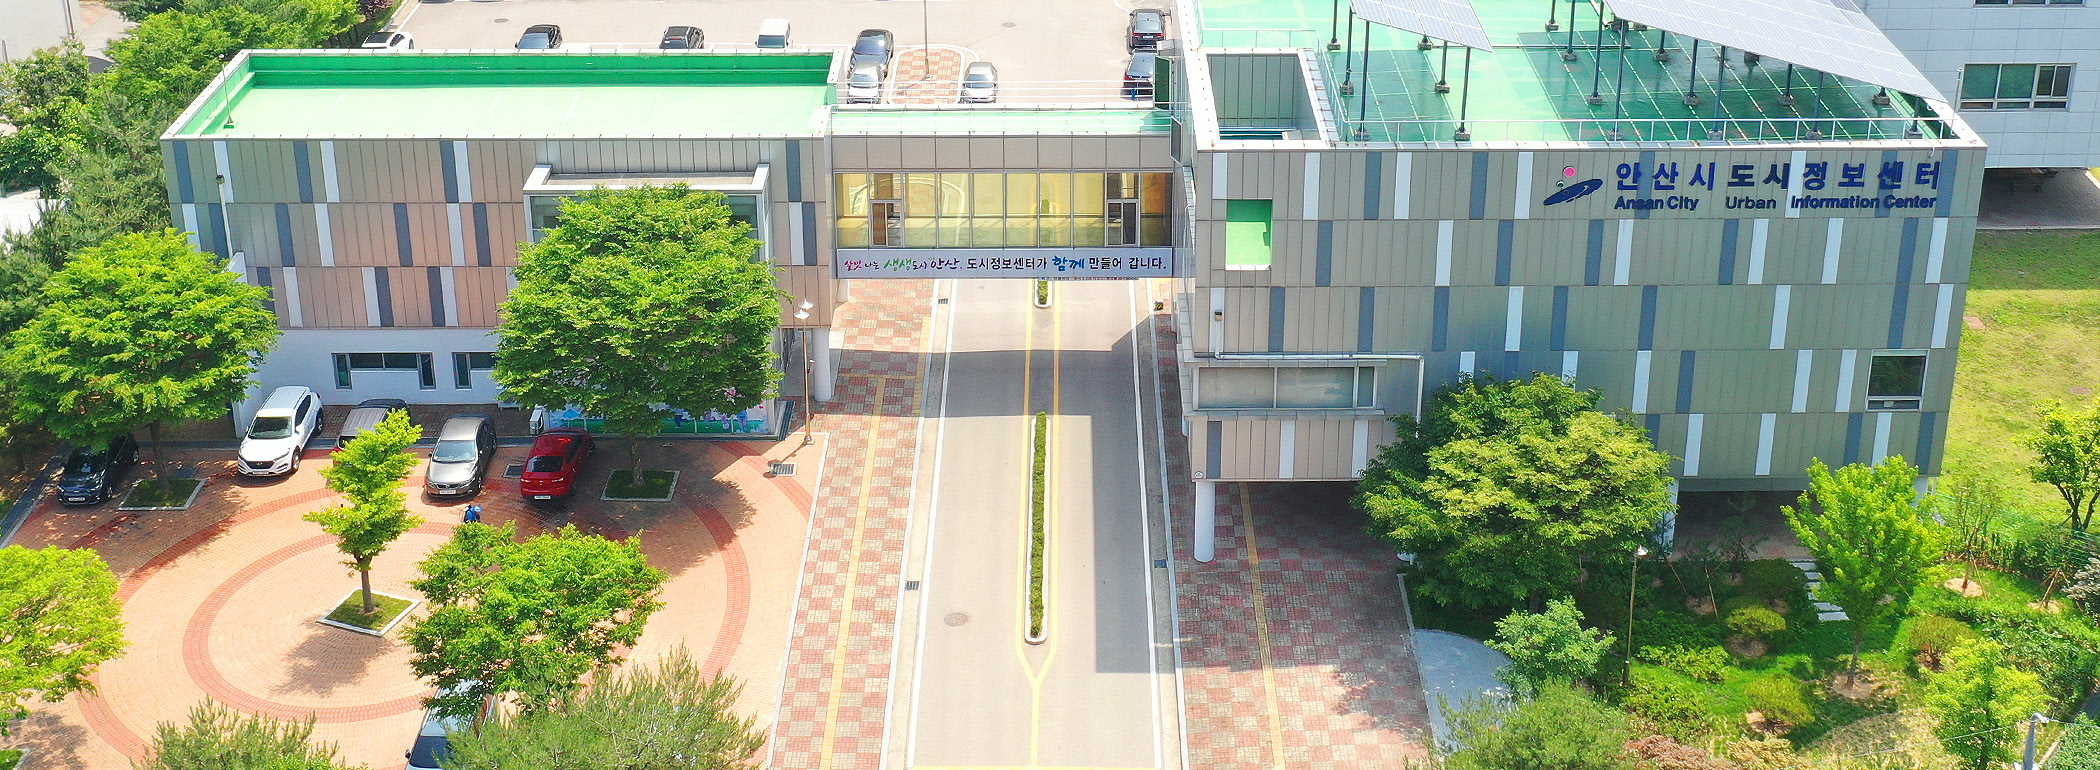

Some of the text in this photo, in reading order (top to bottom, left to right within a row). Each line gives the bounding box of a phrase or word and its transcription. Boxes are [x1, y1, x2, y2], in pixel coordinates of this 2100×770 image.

[1616, 161, 1940, 191] 안산시 도시정보센터
[1614, 194, 1937, 211] Ansan City Urban Information Center
[966, 257, 1047, 270] 도시정보센터가
[1052, 255, 1085, 272] 함께
[1089, 257, 1122, 270] 만들어
[1128, 257, 1167, 270] 갑니다.
